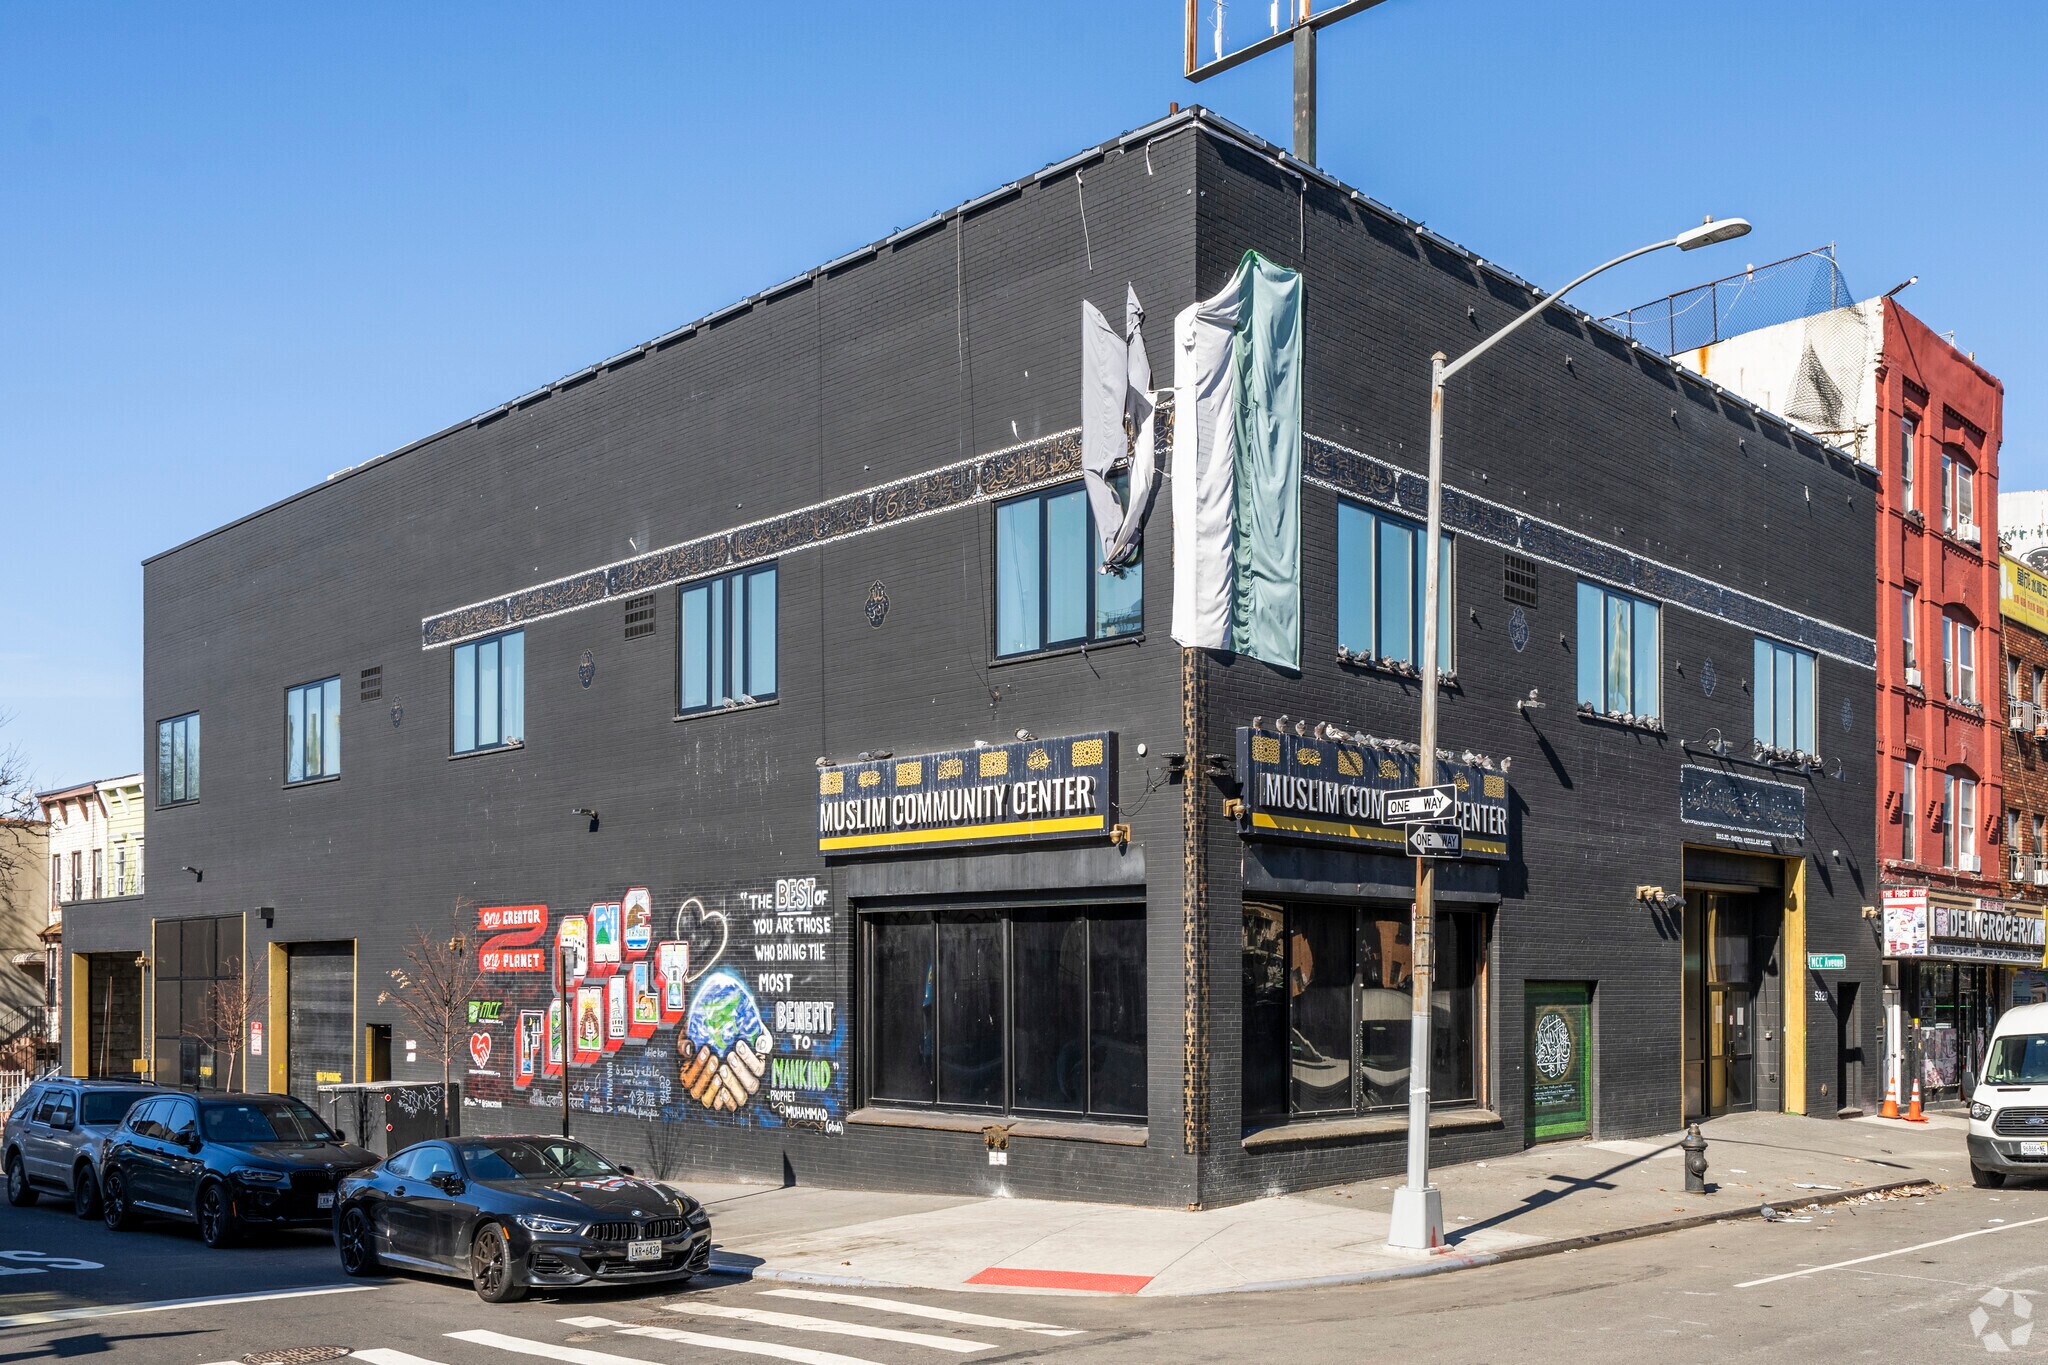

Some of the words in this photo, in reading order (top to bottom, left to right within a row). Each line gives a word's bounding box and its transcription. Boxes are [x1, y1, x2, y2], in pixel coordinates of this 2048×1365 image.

[820, 797, 887, 832] MUSLIM
[892, 785, 1006, 826] COMMUNITY
[1012, 776, 1091, 815] CENTER
[1266, 774, 1340, 815] MUSLIM
[1454, 802, 1507, 836] CENTER
[1390, 800, 1410, 813] ONE
[1424, 796, 1444, 810] WAY
[1416, 834, 1432, 846] ONE
[1441, 834, 1457, 847] WAY
[776, 878, 816, 911] BEST
[814, 890, 828, 906] OF
[1882, 890, 1893, 898] THE
[1895, 889, 1910, 898] FIRST
[1912, 888, 1927, 898] STOP
[502, 909, 541, 925] CREATOR
[753, 918, 773, 935] YOU
[775, 917, 795, 934] ARE
[796, 916, 831, 935] THOSE
[1950, 908, 1976, 939] DELI
[1980, 911, 2033, 945] GROCERY
[556, 887, 651, 986] ONE
[503, 953, 540, 968] PLANET
[755, 944, 775, 961] WHO
[777, 943, 807, 960] BRING
[807, 943, 826, 960] THE
[1811, 957, 1823, 967] MCC
[1824, 957, 1844, 968] Avenue
[759, 973, 794, 992] MOST
[516, 941, 690, 1085] FAMILY
[775, 1001, 834, 1034] BENEFIT
[792, 1034, 811, 1050] TO
[786, 1105, 828, 1121] MUHAMMAD
